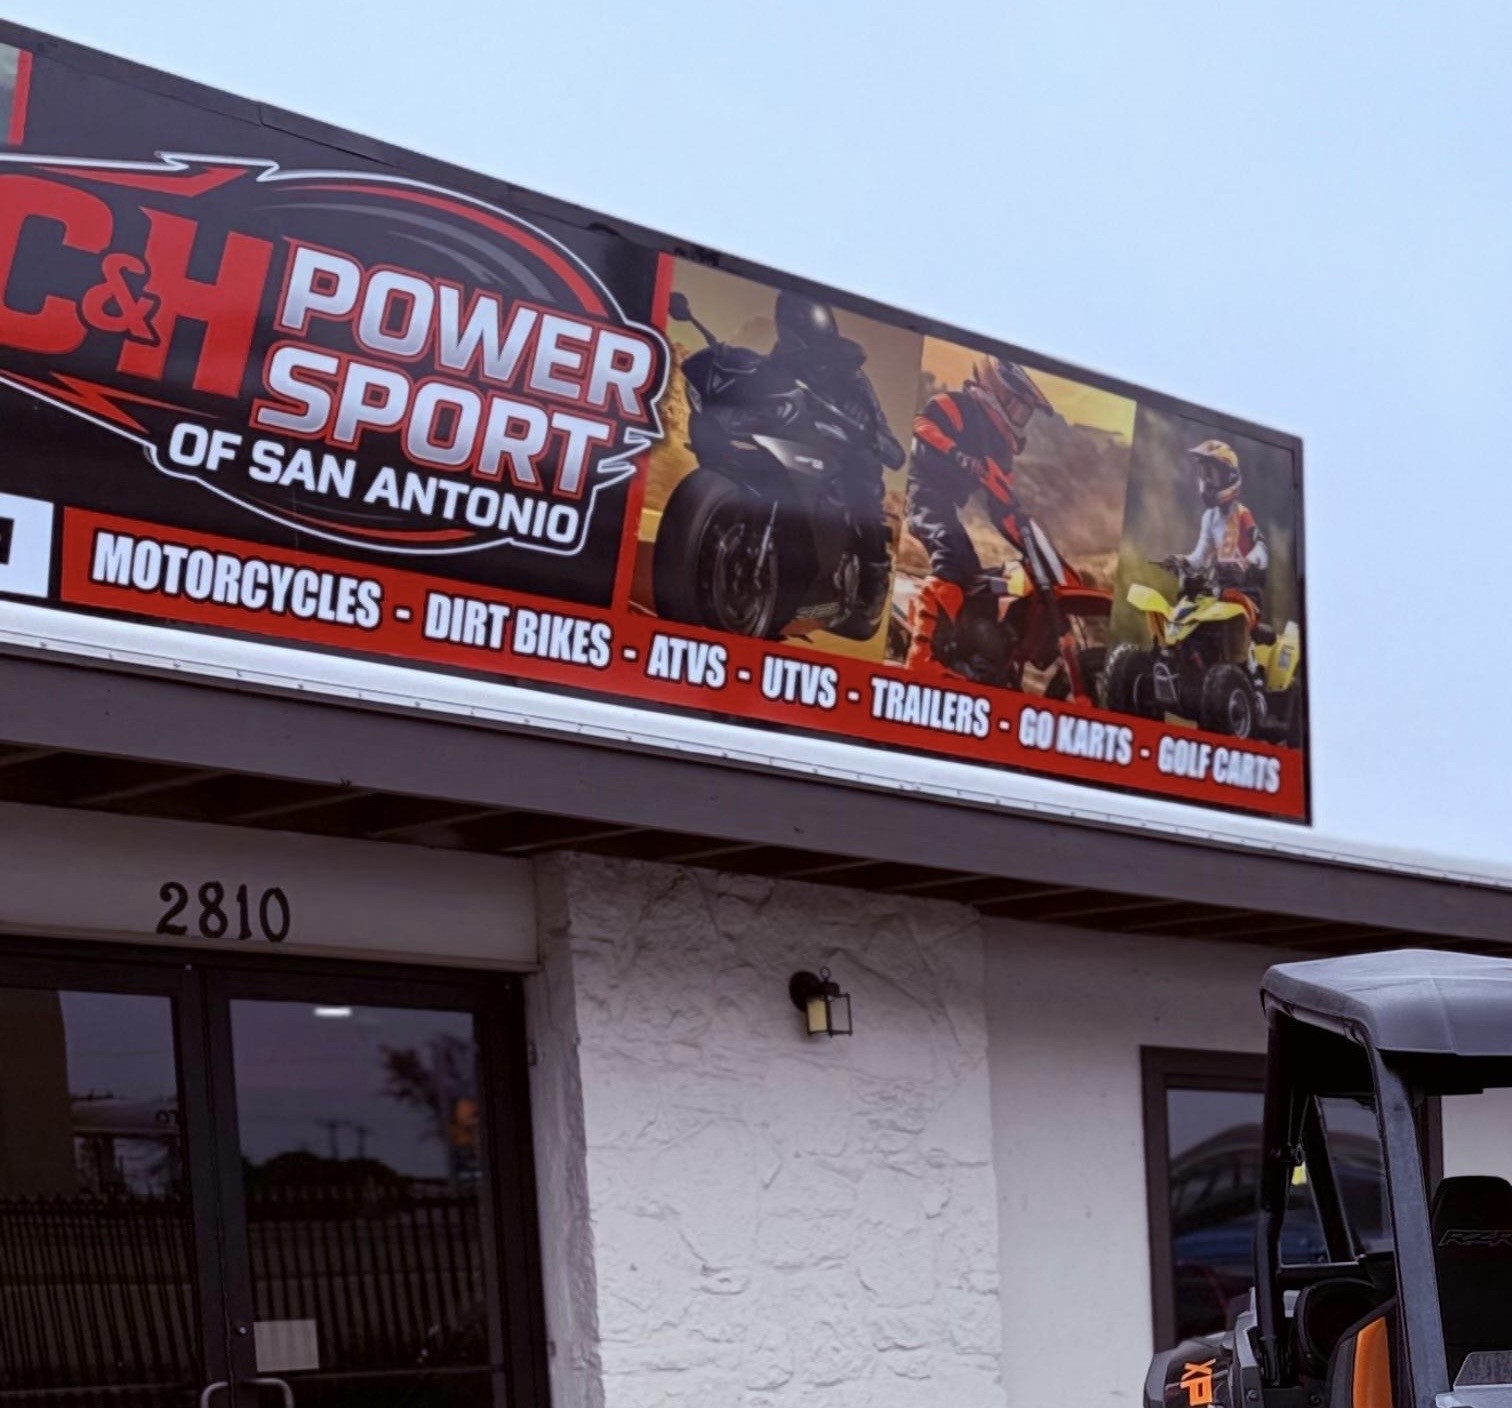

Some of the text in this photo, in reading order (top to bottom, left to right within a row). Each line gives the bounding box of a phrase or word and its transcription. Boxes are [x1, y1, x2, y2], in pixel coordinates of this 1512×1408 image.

[0, 174, 274, 398] C&H
[281, 245, 654, 417] POWER
[168, 422, 580, 545] OF SAN ANTONIO
[256, 344, 610, 495] SPORT
[92, 531, 382, 630] MOTORCYCLES
[424, 592, 511, 649] DIRT
[514, 616, 612, 668] BIKES
[646, 633, 728, 689] ATVS
[761, 654, 838, 708] UTVS
[871, 676, 991, 738] TRAILERS
[1018, 707, 1053, 750] GO
[1056, 714, 1134, 765] KARTS
[1157, 735, 1210, 780] GOLF
[1212, 746, 1281, 794] CARTS
[155, 880, 291, 943] 2810
